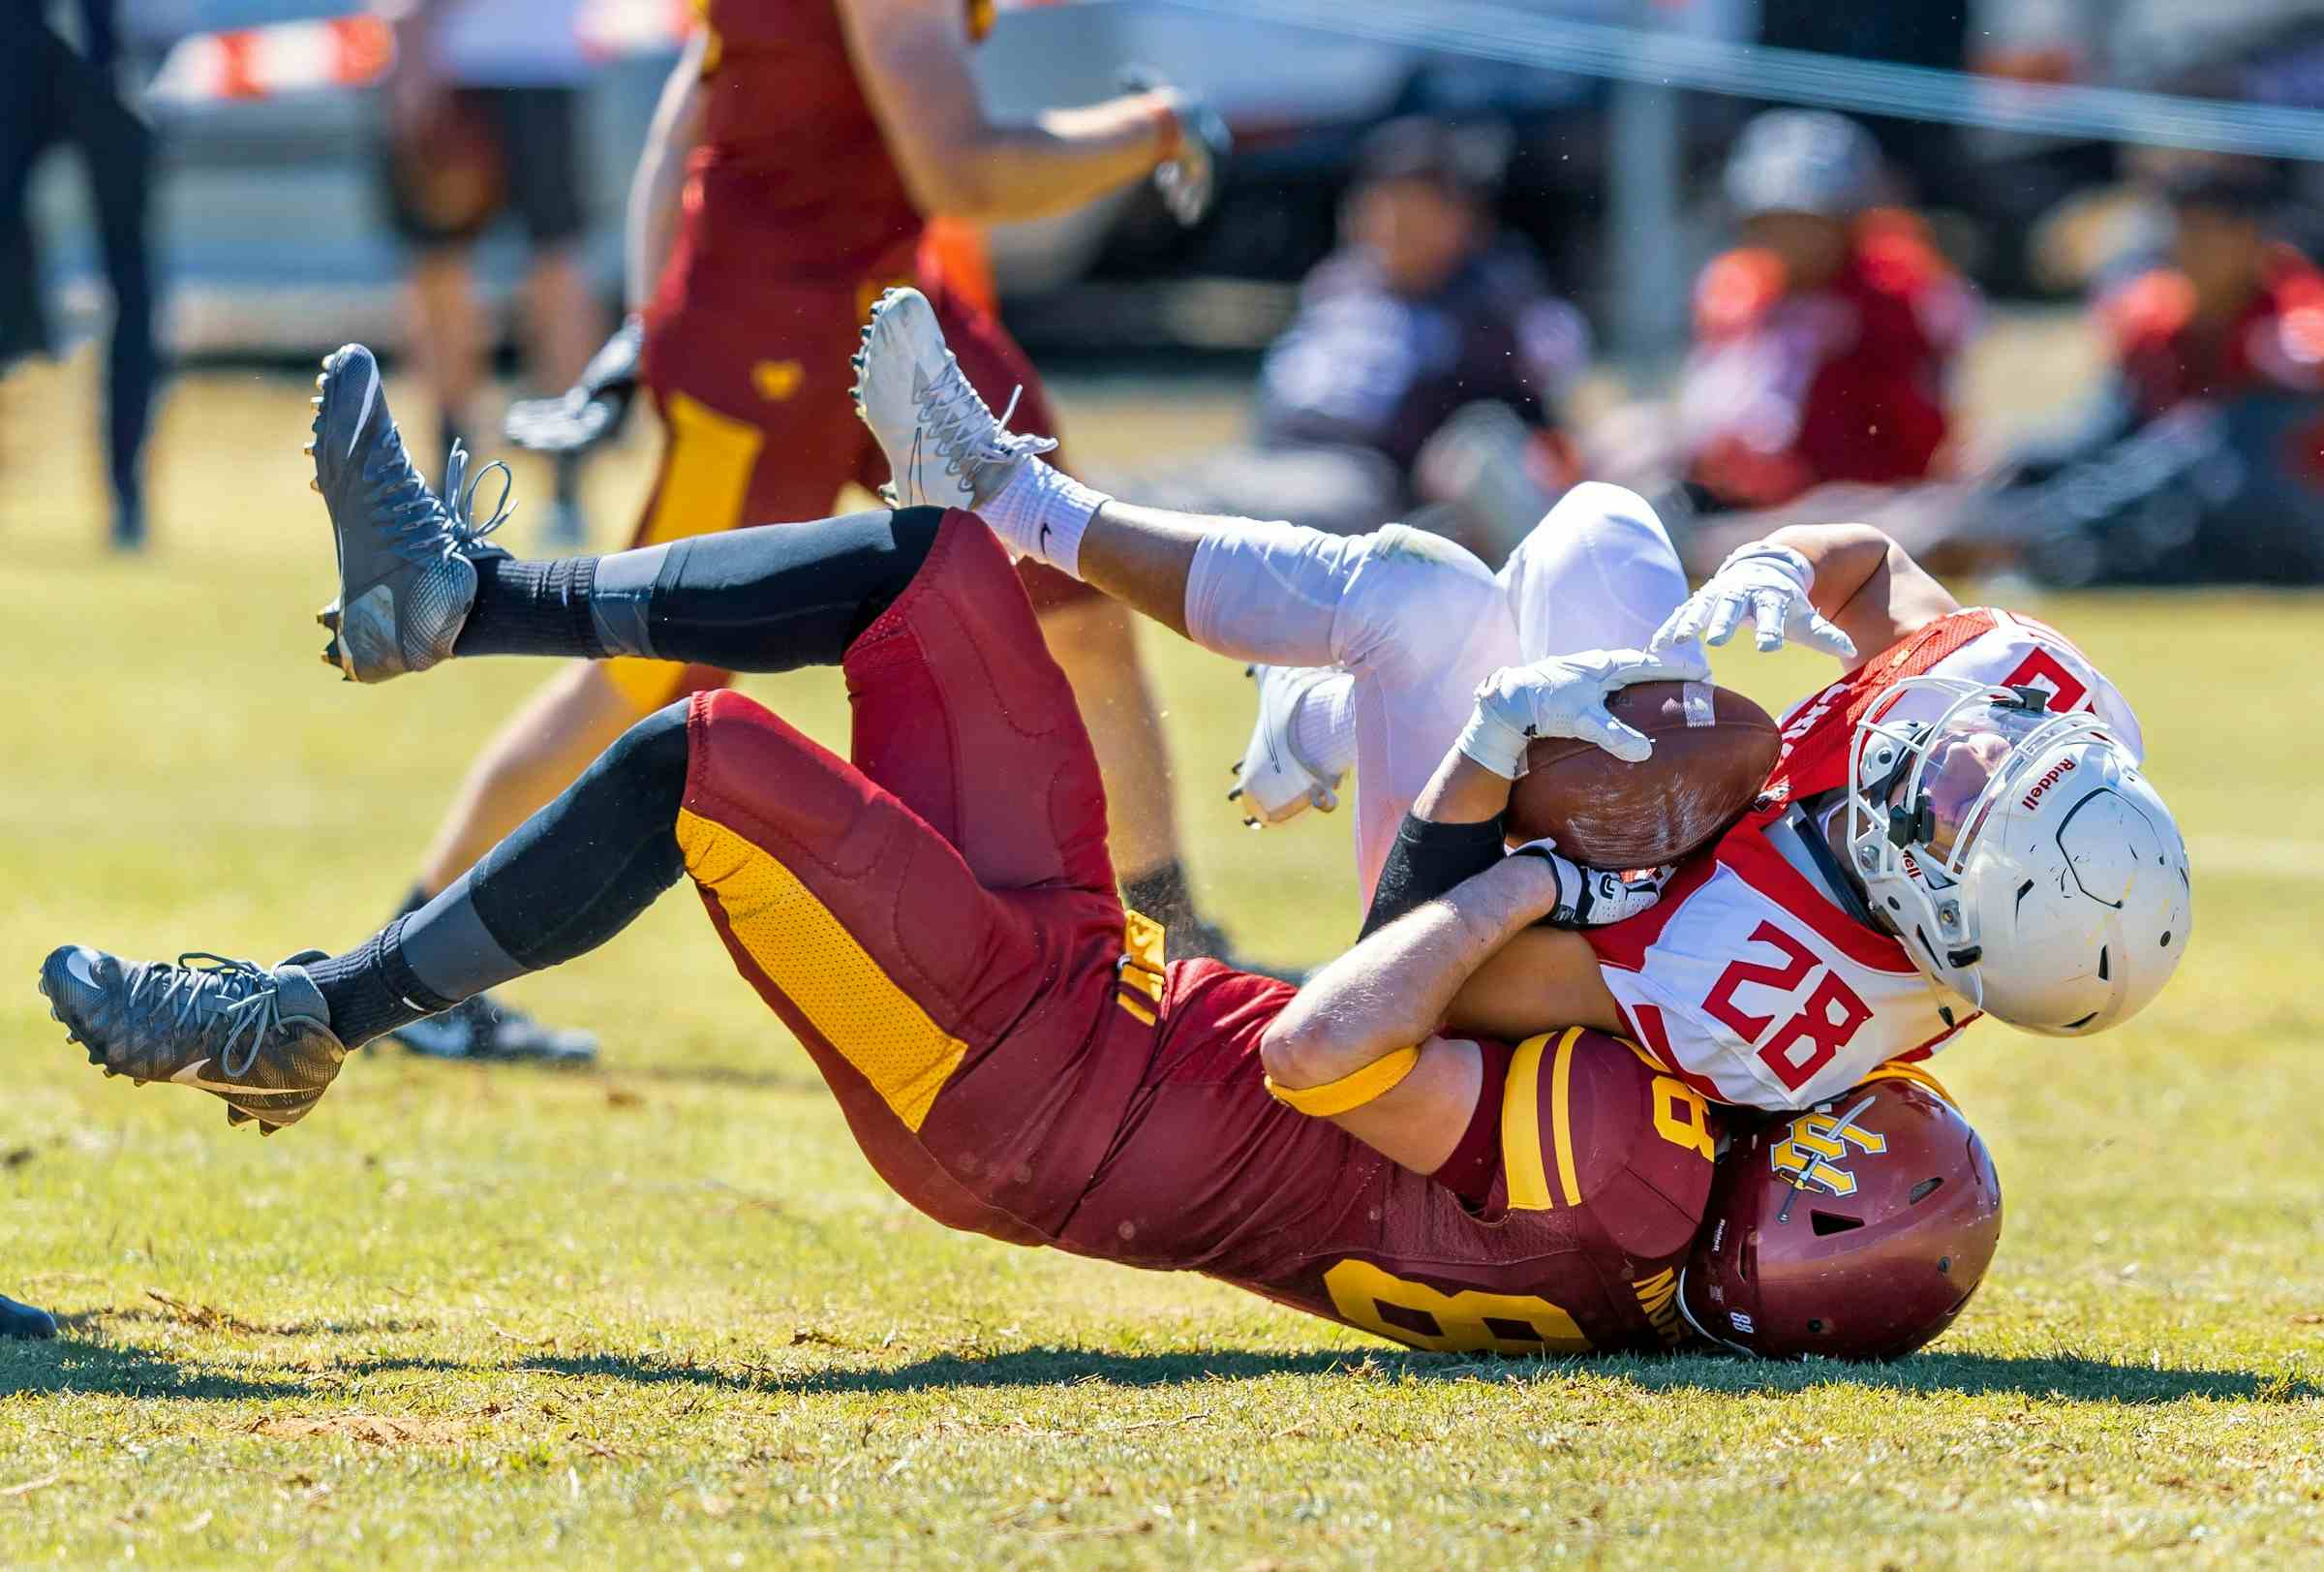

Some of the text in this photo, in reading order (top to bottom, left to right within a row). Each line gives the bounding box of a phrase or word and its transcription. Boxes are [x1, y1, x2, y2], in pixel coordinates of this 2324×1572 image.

[2022, 758, 2077, 811] Riddell
[1701, 919, 1875, 1093] 28
[1729, 1310, 1755, 1334] 88
